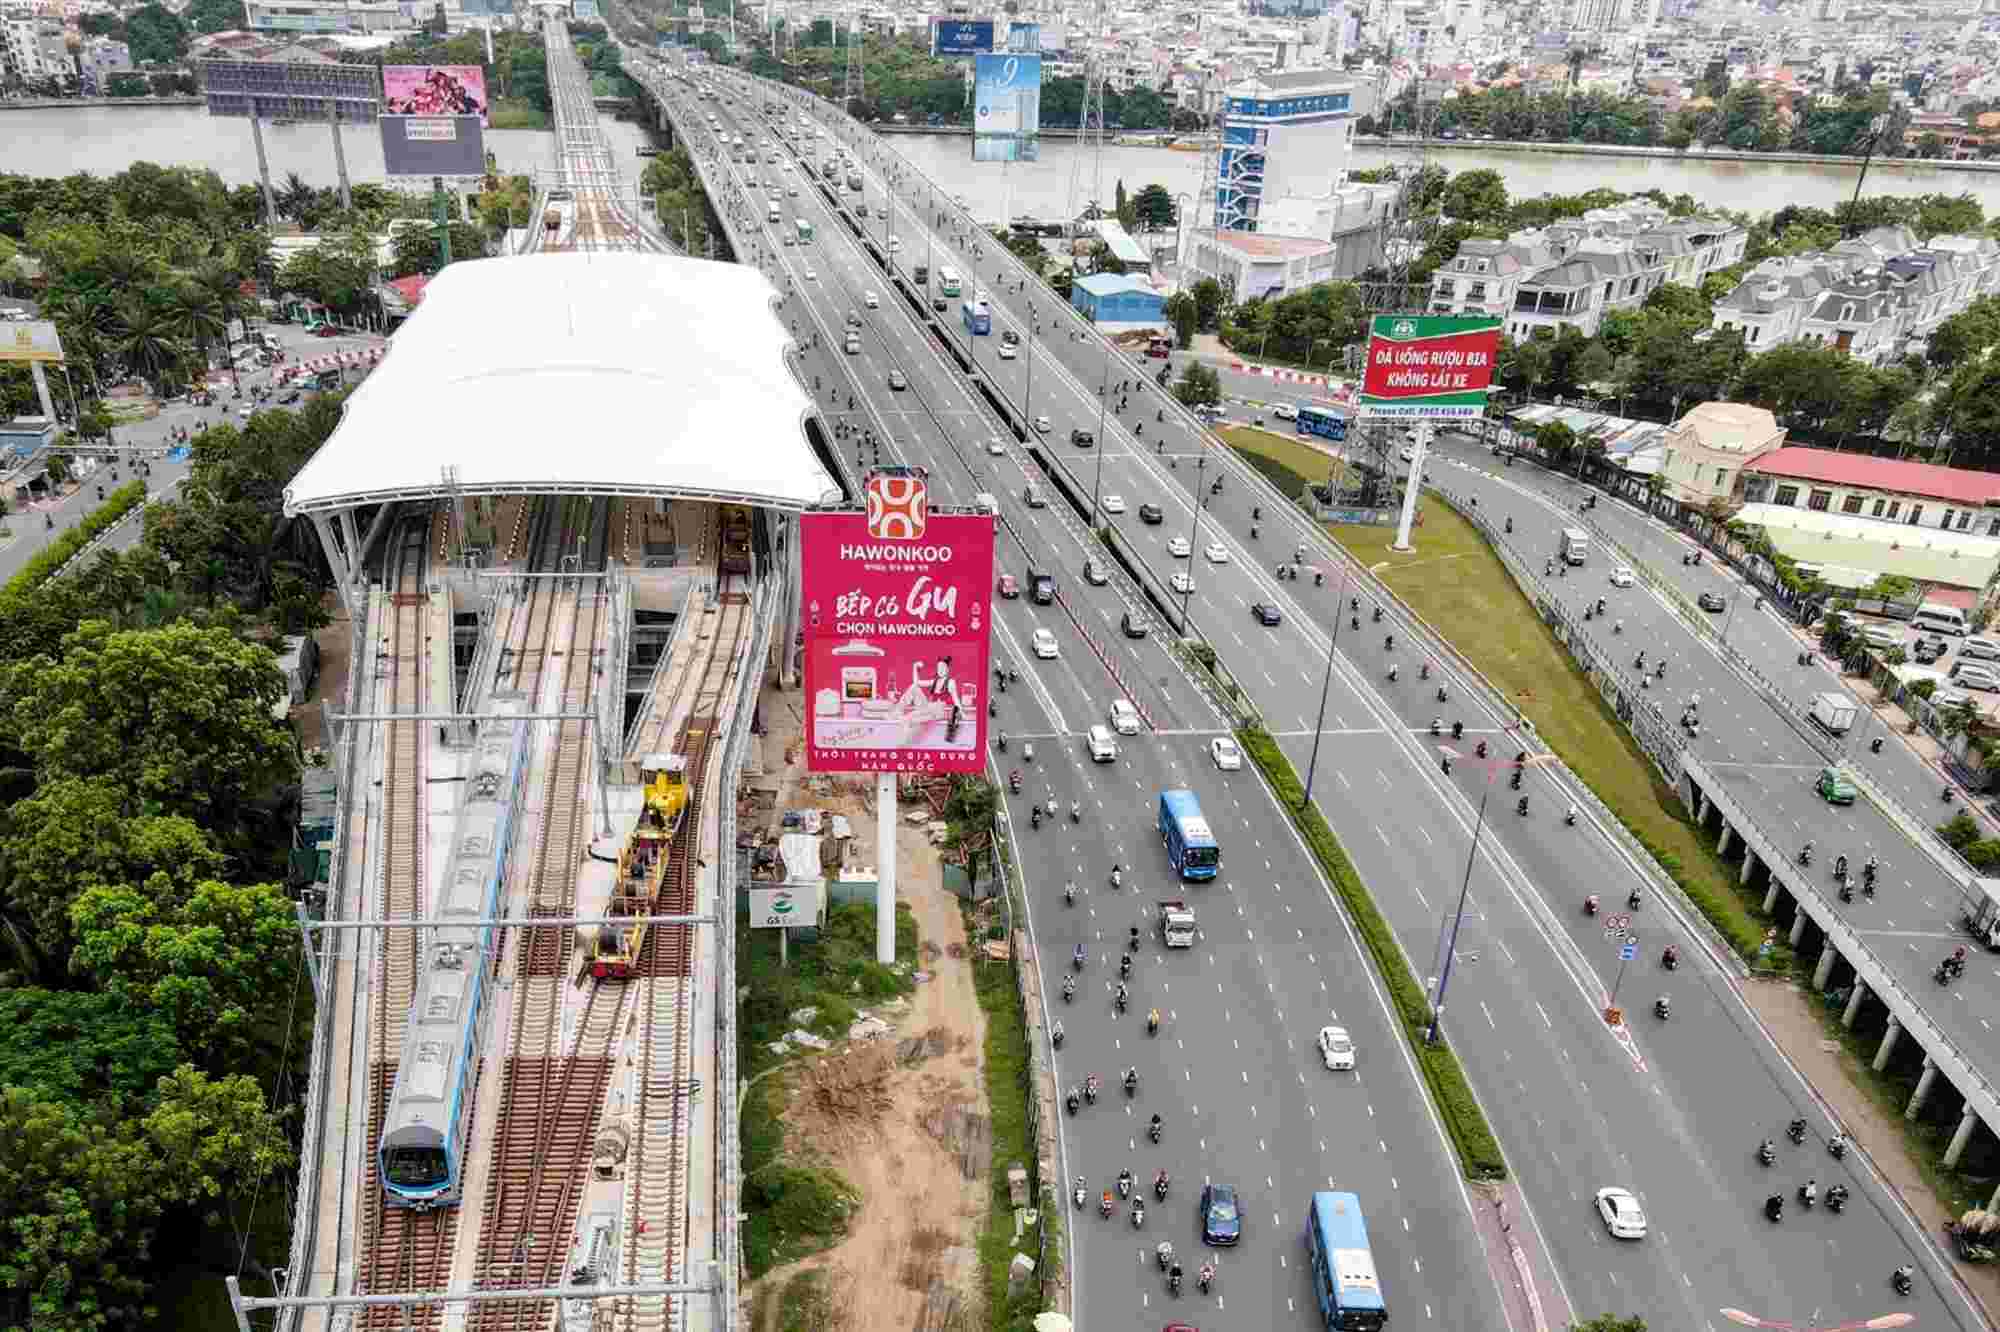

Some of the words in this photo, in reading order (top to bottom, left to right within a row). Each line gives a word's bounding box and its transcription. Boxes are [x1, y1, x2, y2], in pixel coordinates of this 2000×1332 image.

[1466, 351, 1487, 366] BIA
[1452, 373, 1468, 387] XE
[840, 544, 952, 562] HAWONKOO
[878, 623, 956, 636] HAWONKOO
[855, 751, 898, 760] TRANG
[907, 751, 931, 760] GIA
